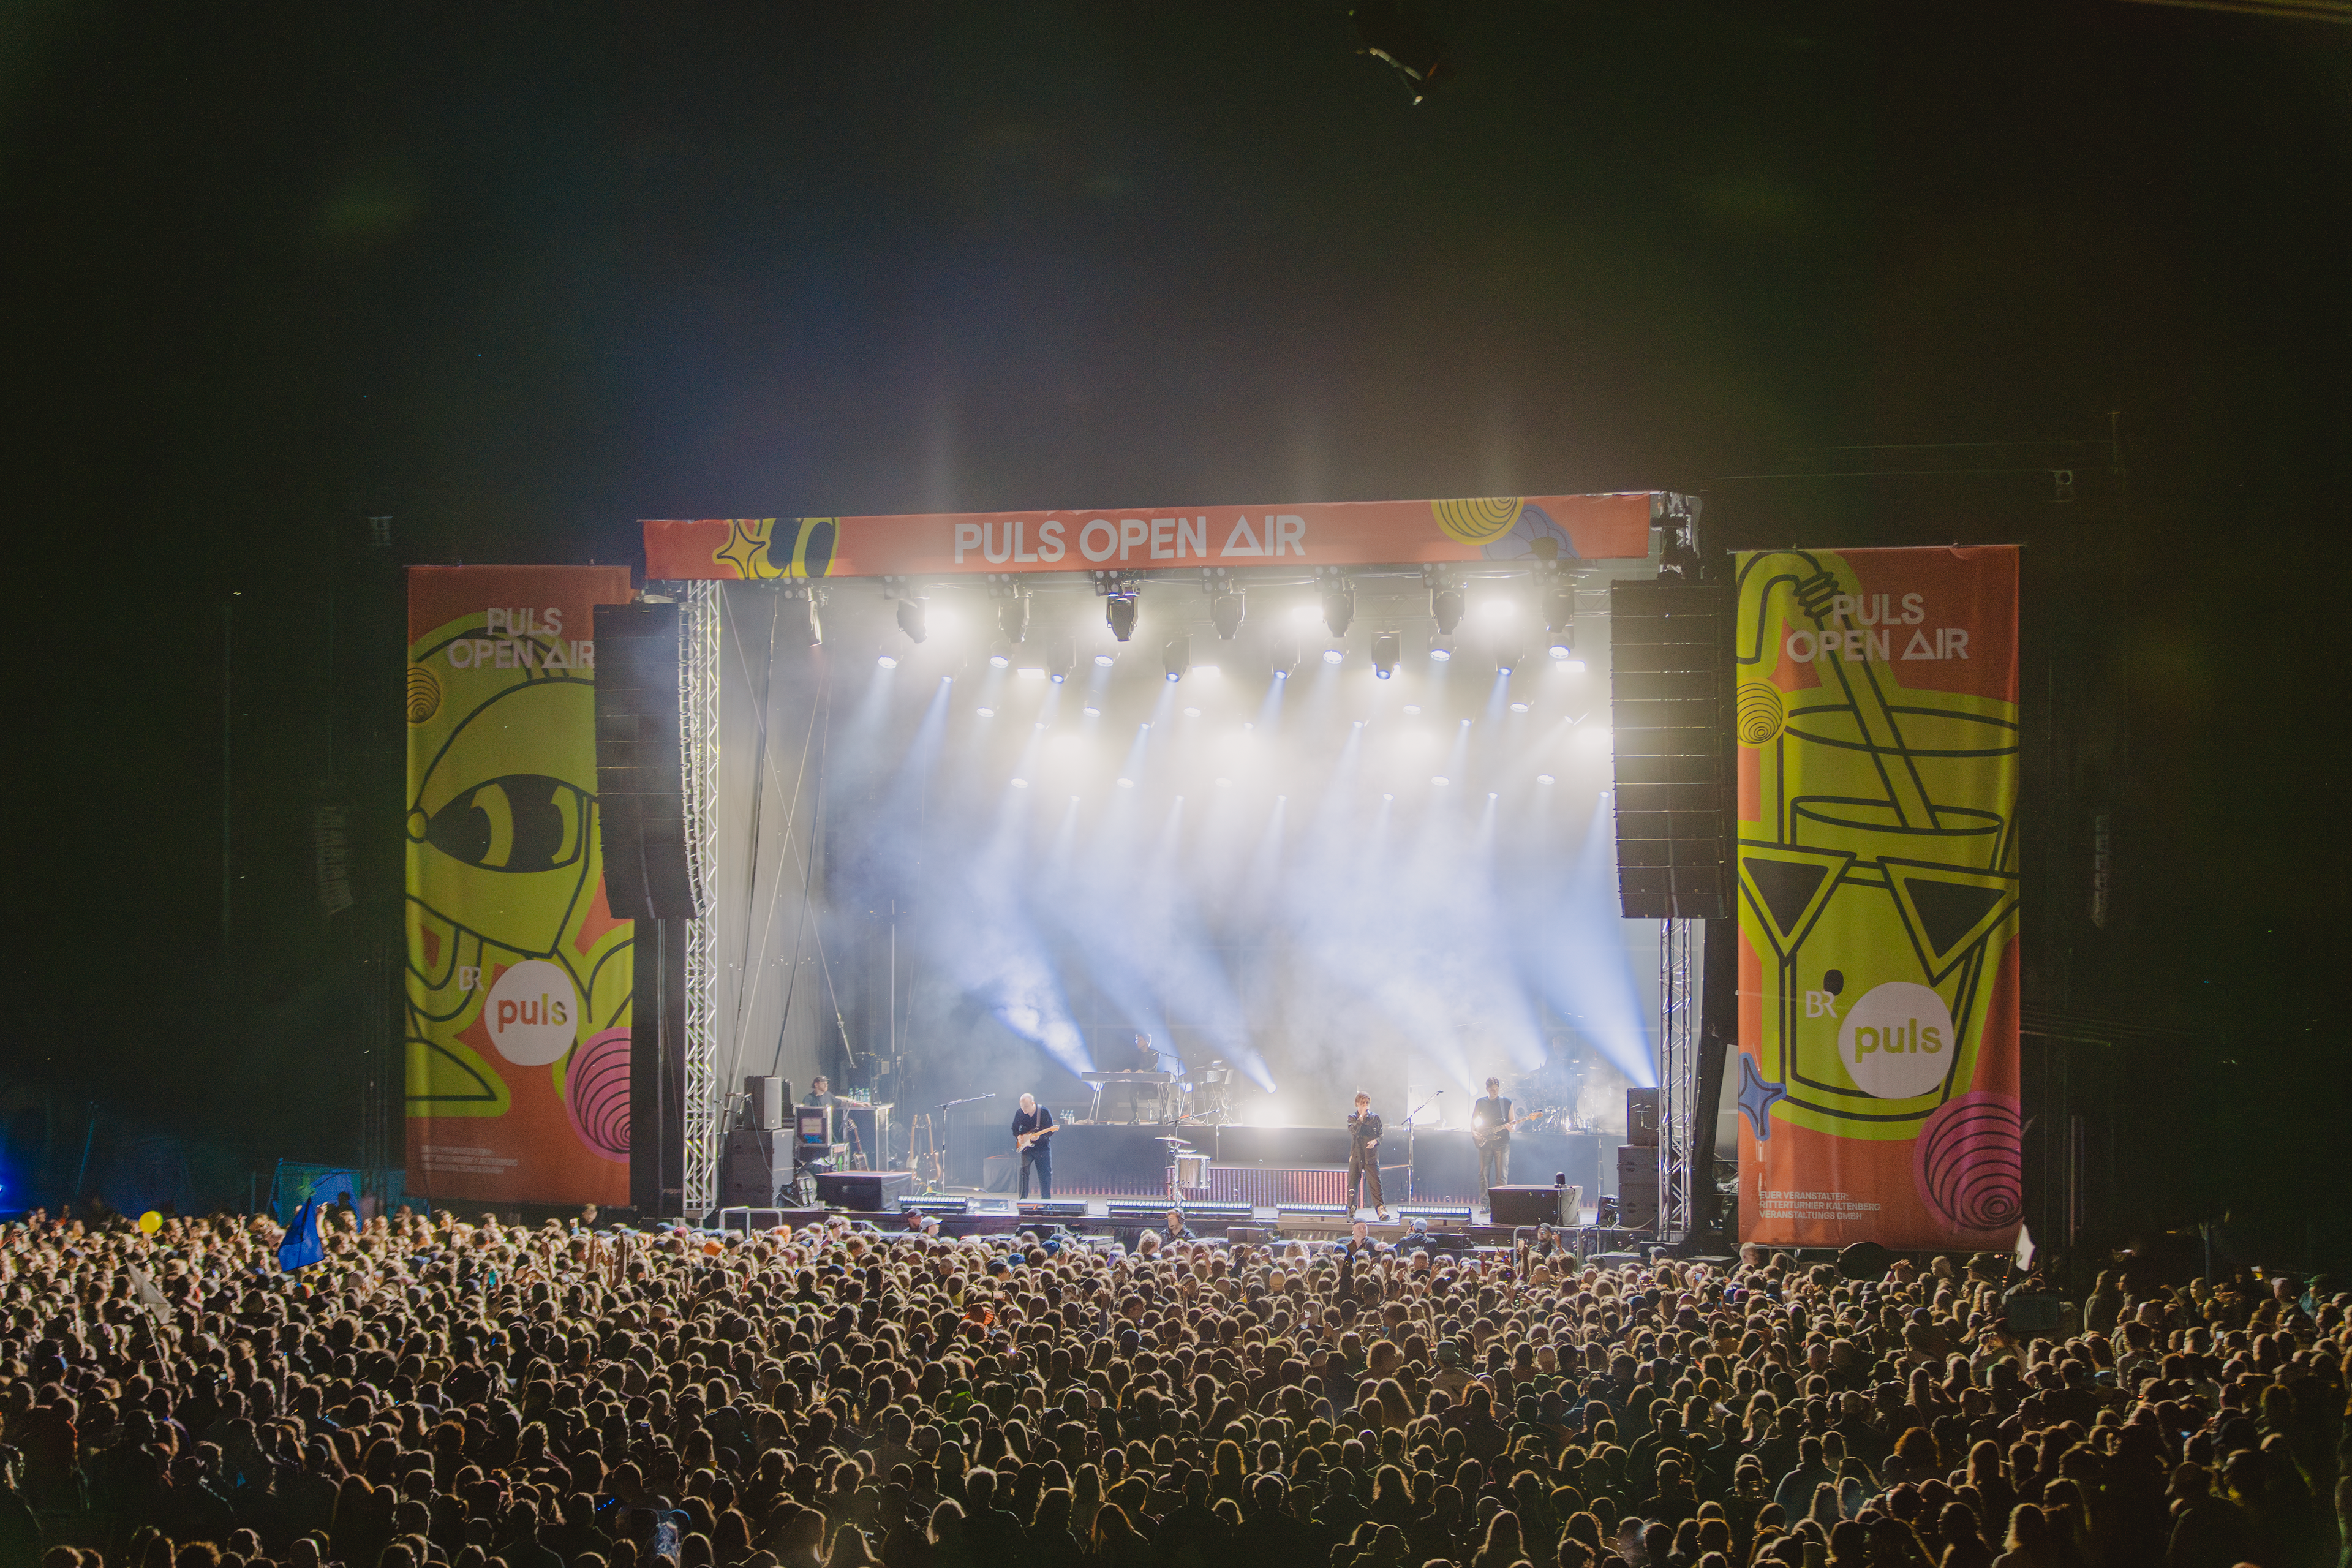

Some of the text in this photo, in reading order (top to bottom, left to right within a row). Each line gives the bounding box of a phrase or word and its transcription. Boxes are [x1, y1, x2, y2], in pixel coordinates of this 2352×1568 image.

[955, 514, 1306, 564] PULS OPEN AIR
[486, 608, 562, 636] PULS
[1833, 592, 1925, 626] PULS
[447, 638, 594, 669] OPEN AIR
[1787, 628, 1969, 663] OPEN AIR
[459, 966, 483, 990] BR
[497, 993, 567, 1033] puls
[1805, 990, 1838, 1018] BR
[1855, 1018, 1942, 1063] puls
[1759, 1201, 1825, 1210] RITTERTURNIER
[1759, 1210, 1835, 1219] VERANSTALTUNGS
